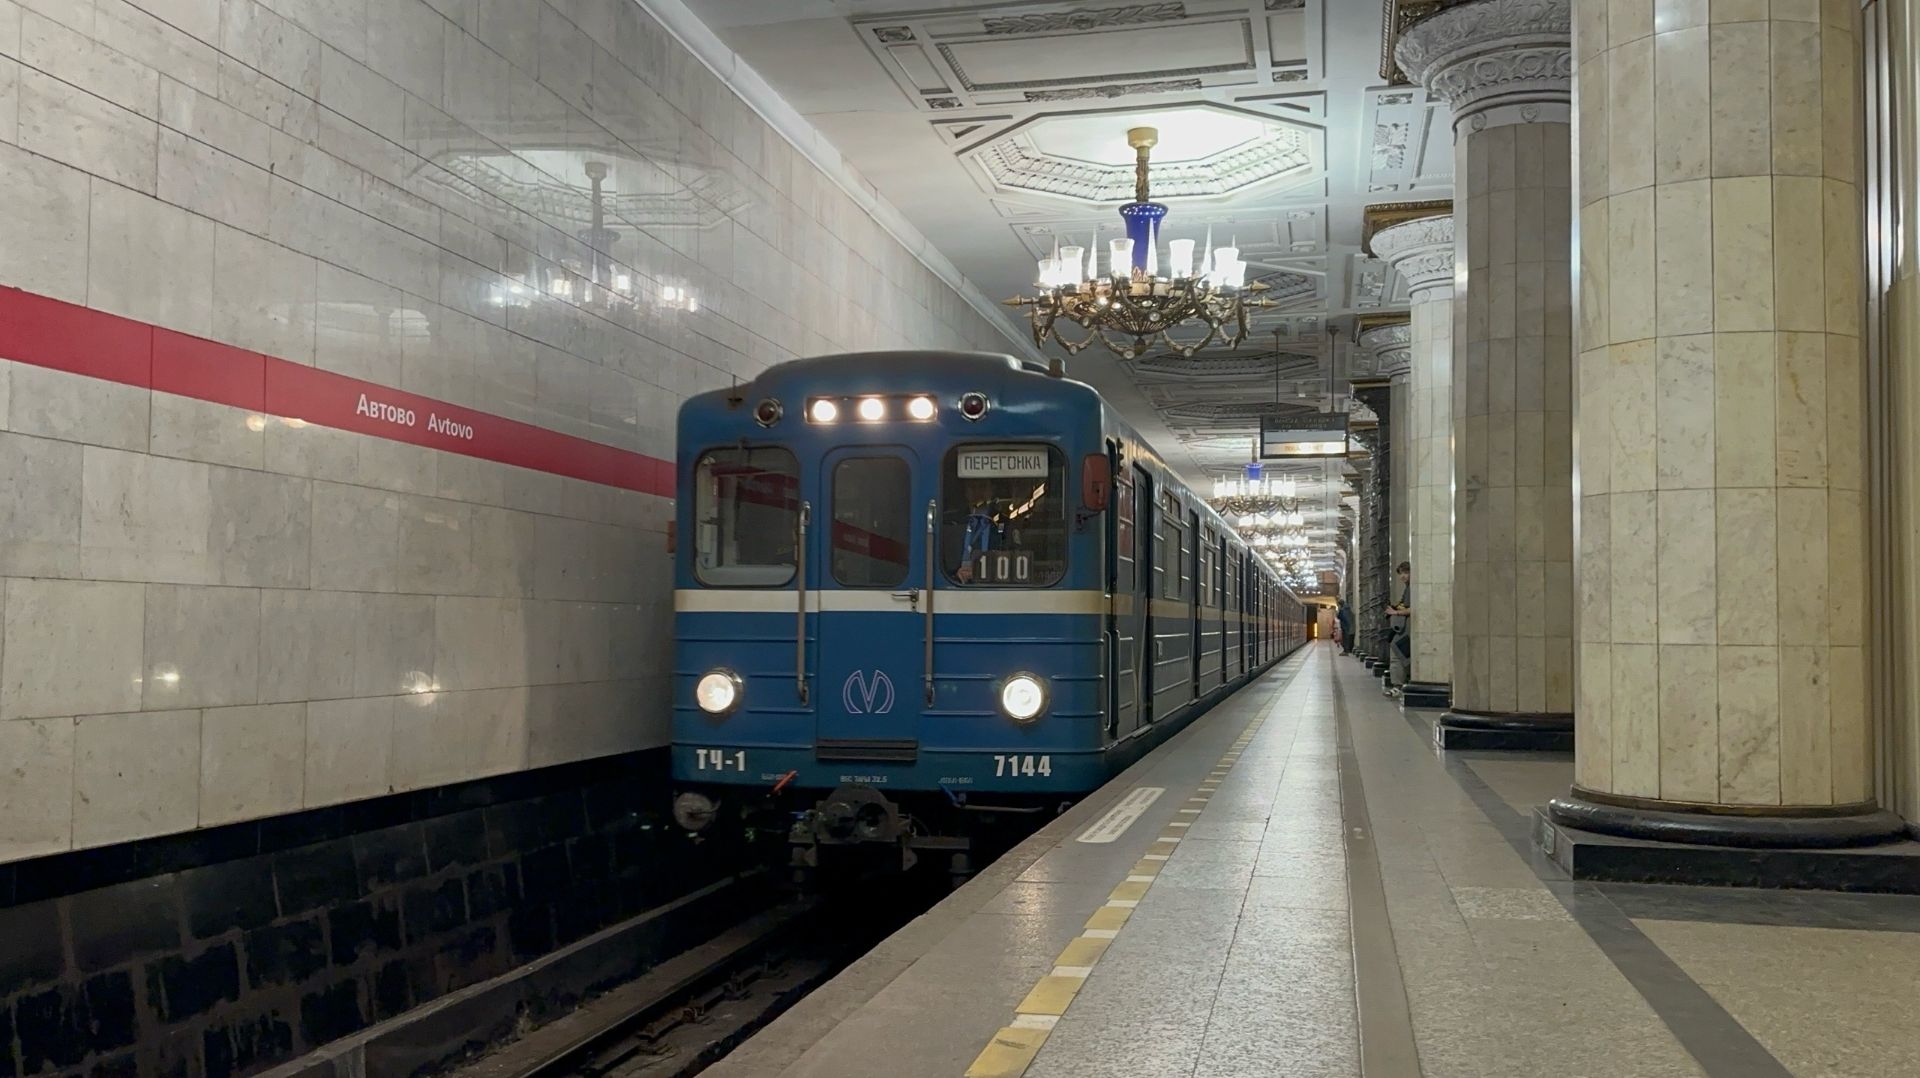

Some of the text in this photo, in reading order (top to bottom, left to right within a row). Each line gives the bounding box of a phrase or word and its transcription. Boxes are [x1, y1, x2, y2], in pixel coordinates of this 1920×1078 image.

[356, 393, 416, 427] Автово
[428, 412, 474, 441] Avtovo
[964, 455, 1042, 471] ПЕРЕГОНКА
[979, 554, 1029, 580] 100
[696, 748, 746, 772] ТЧ-1
[993, 755, 1052, 777] 7144
